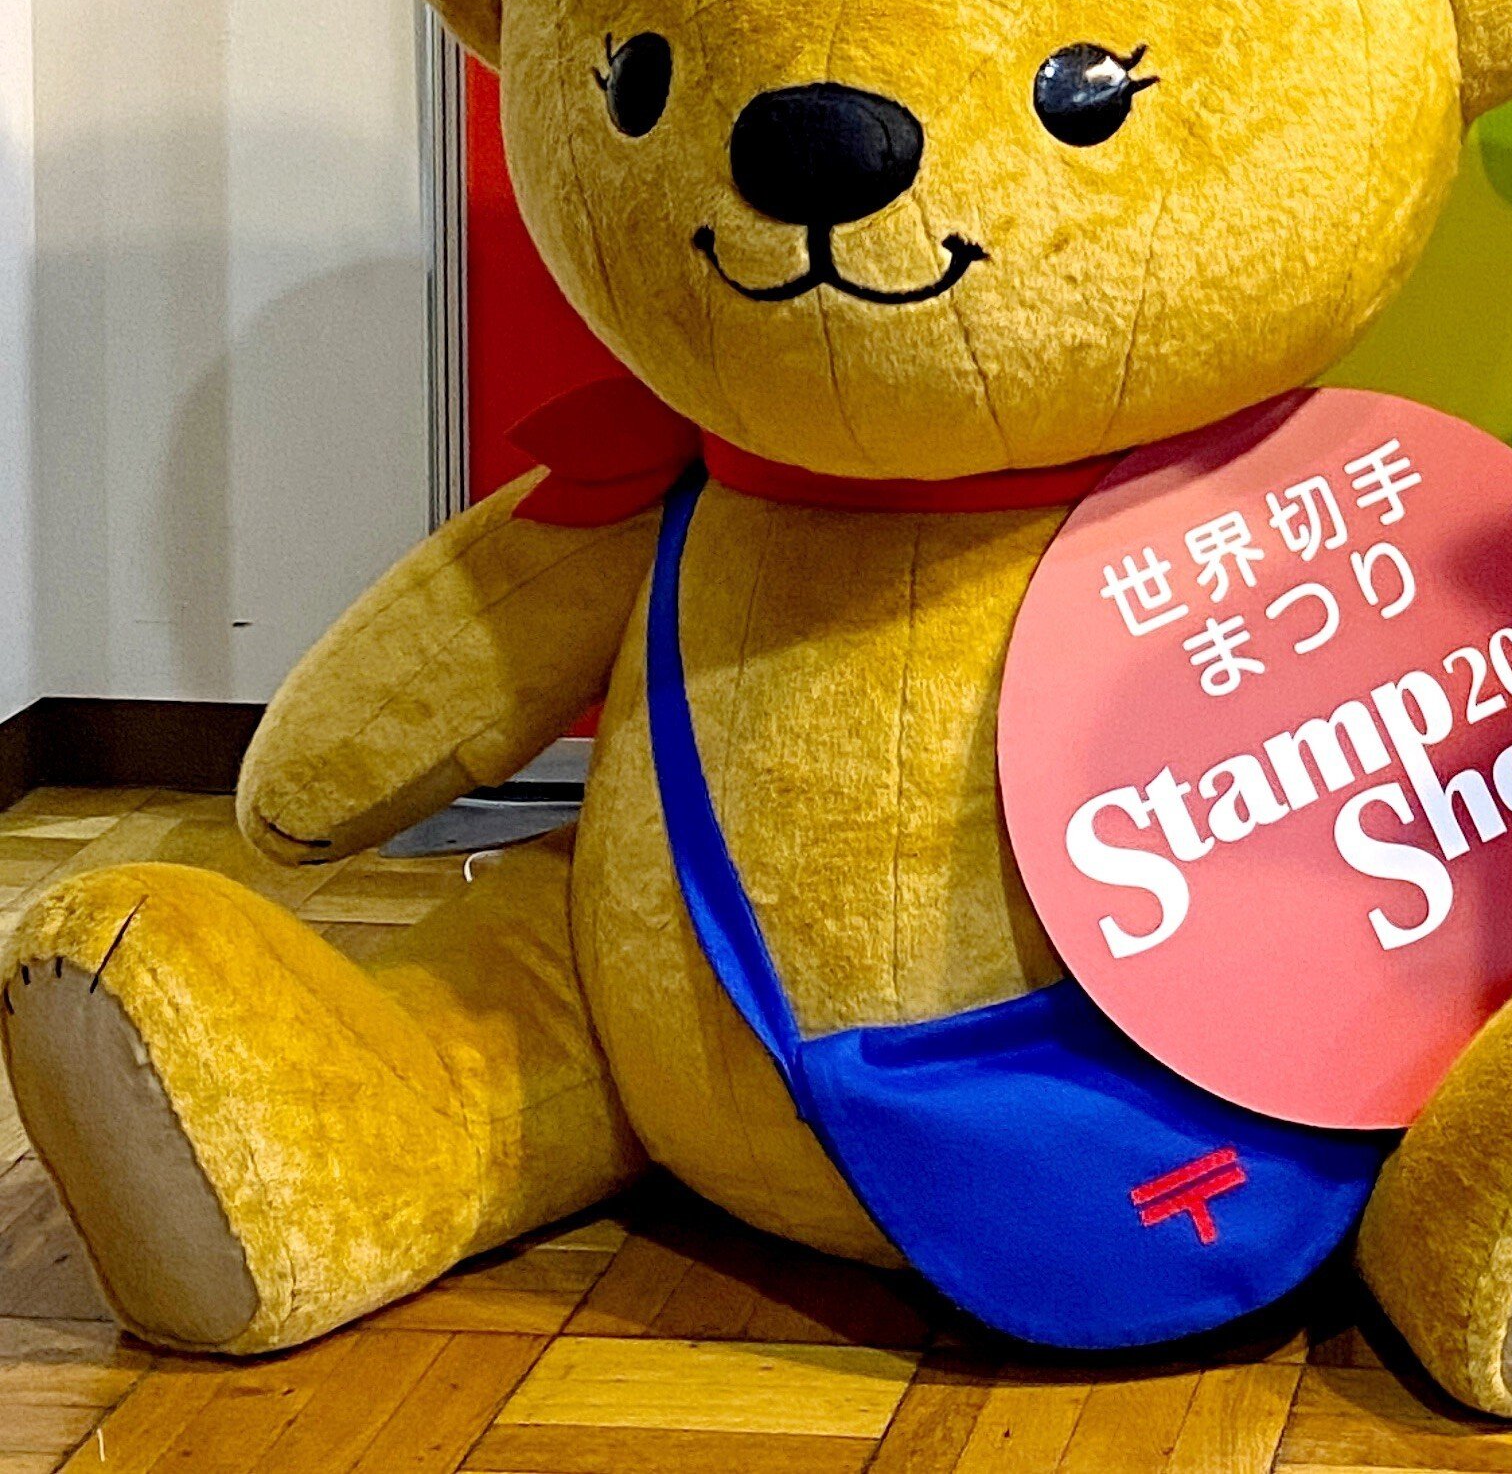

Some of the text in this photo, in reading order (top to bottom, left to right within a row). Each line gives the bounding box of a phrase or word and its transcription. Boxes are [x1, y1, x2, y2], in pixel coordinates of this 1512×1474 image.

[1100, 439, 1422, 637] 世界切手
[1183, 541, 1417, 697] まつり
[1065, 668, 1454, 960] Stamp
